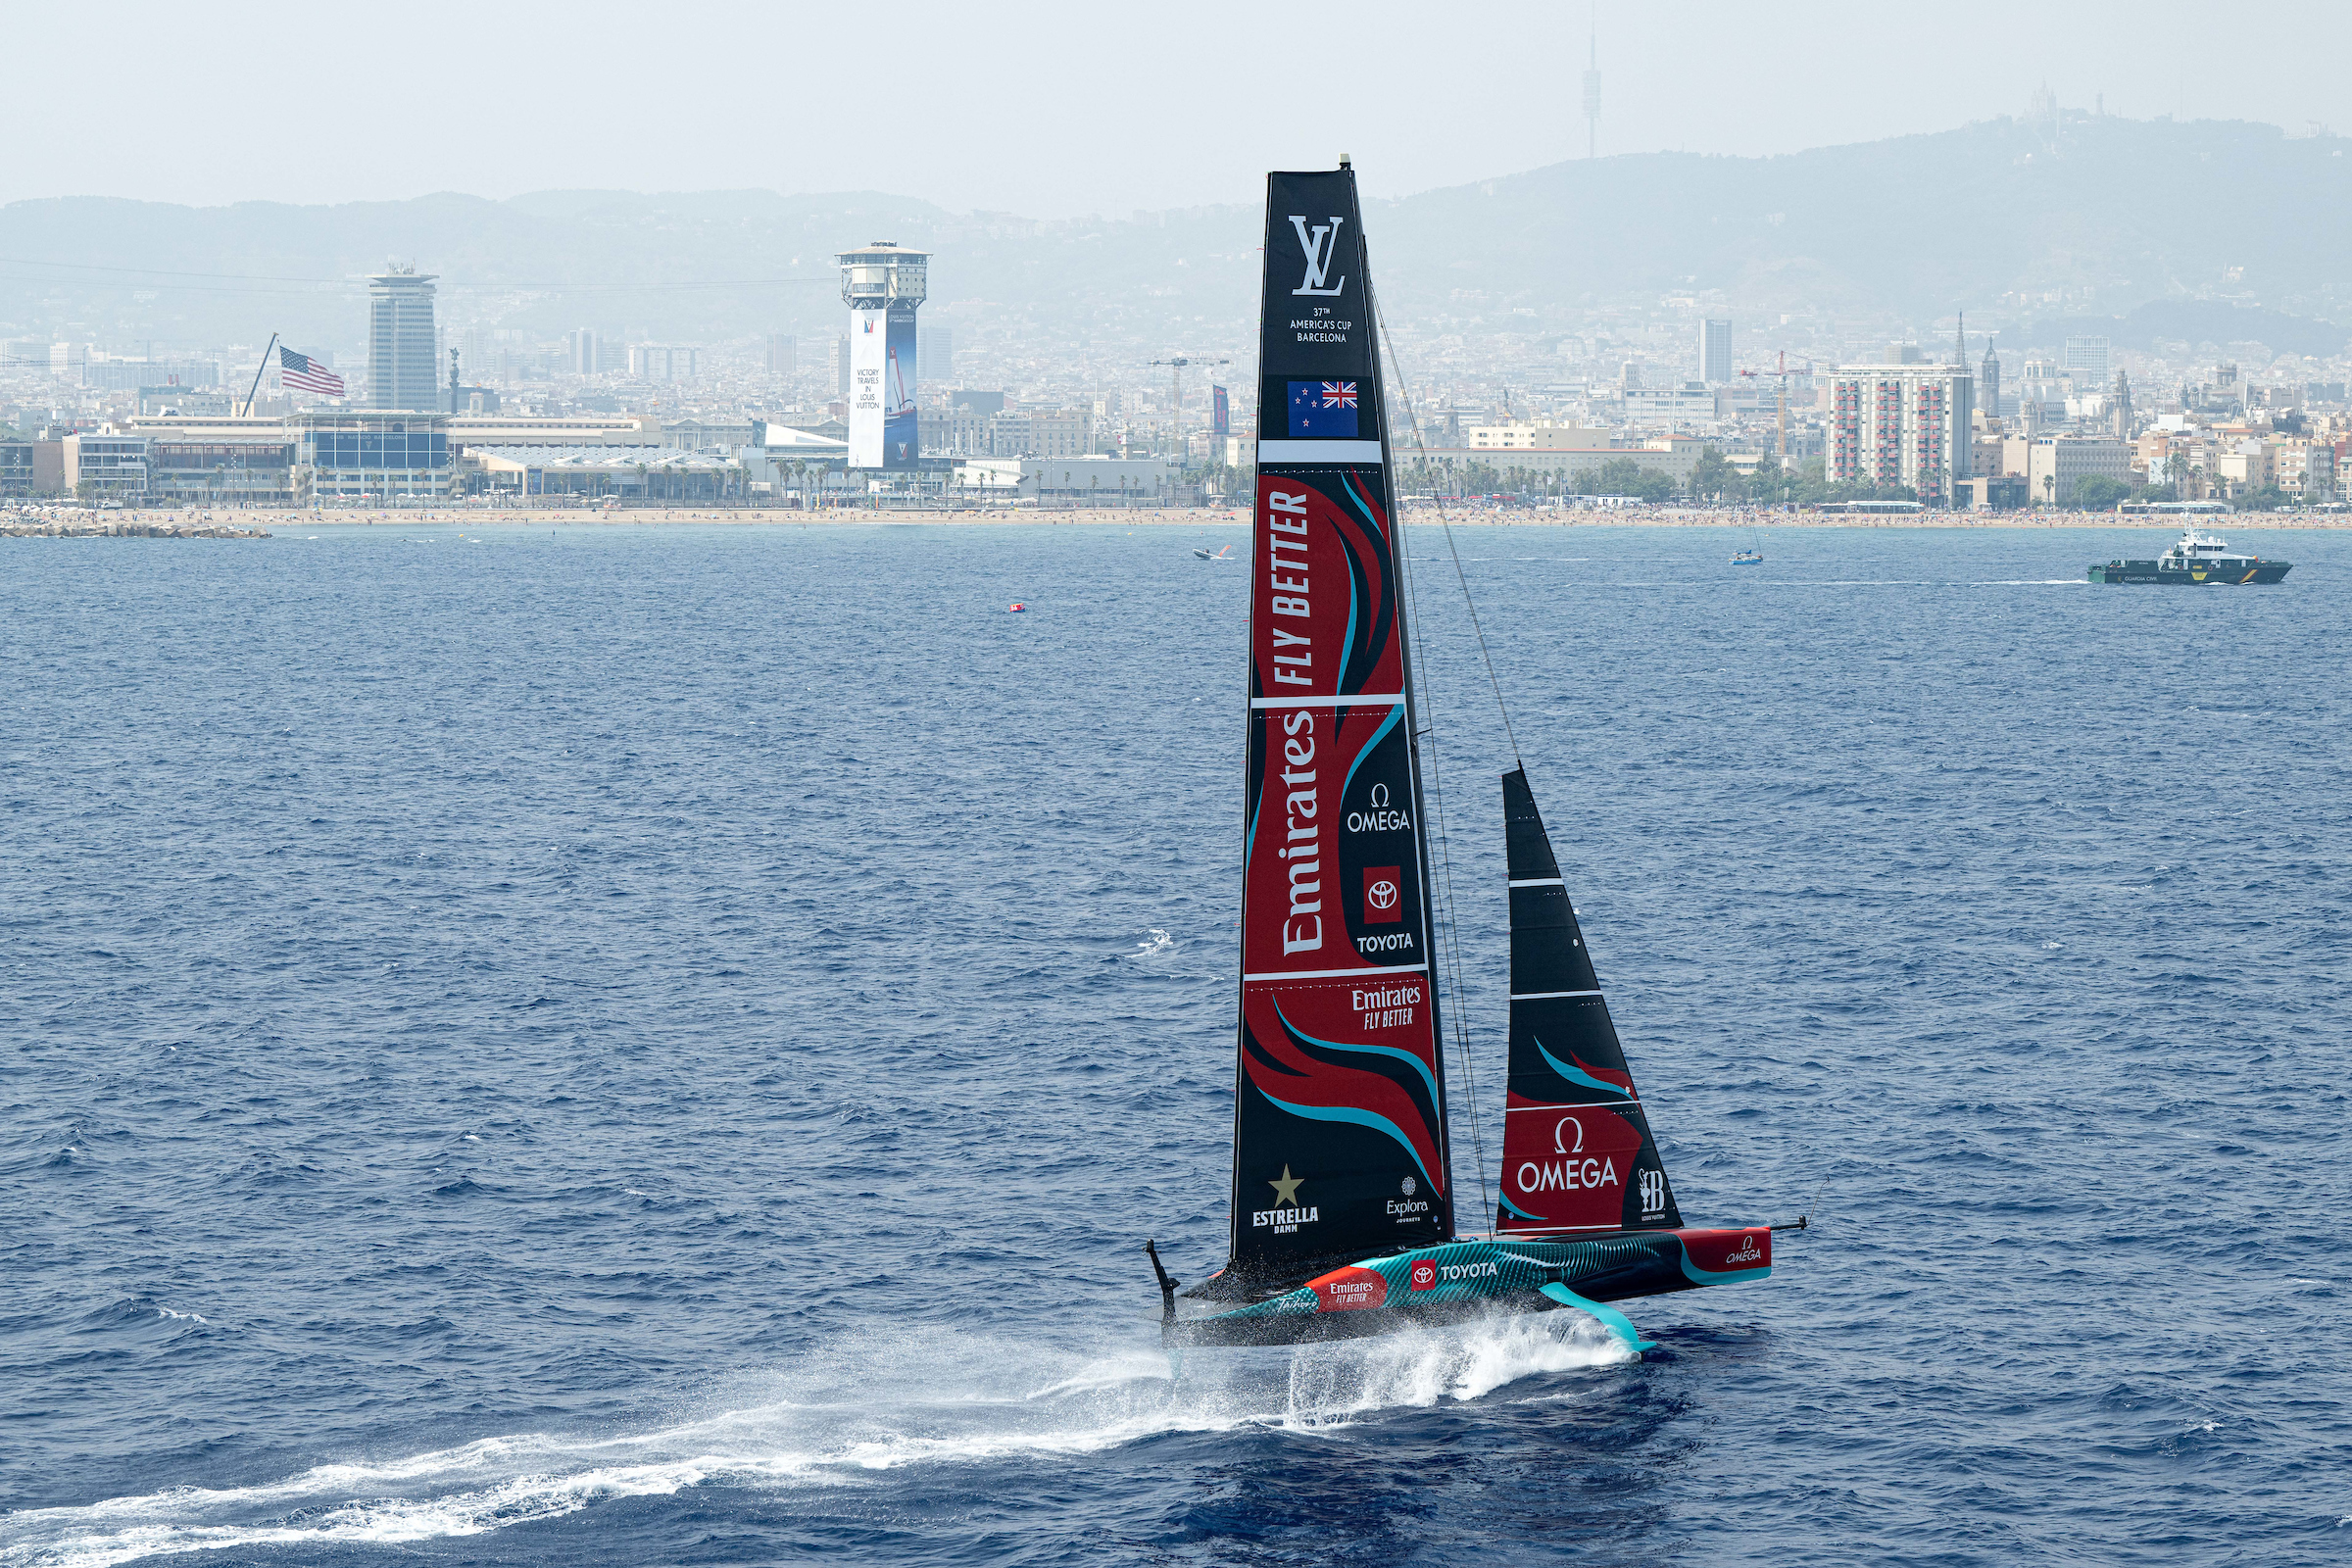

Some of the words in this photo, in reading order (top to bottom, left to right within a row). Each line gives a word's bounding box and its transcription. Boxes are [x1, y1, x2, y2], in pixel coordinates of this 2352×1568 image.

[1290, 319, 1336, 330] AMERICA'S
[1337, 320, 1352, 330] CUP
[1297, 332, 1348, 343] BARCELONA
[857, 376, 879, 385] TRAVELS
[1269, 490, 1311, 618] BETTER
[1272, 627, 1313, 686] FLY
[1347, 809, 1411, 833] OMEGA
[1278, 710, 1323, 957] Emirates
[1356, 932, 1414, 954] TOYOTA
[1351, 985, 1421, 1011] Emirates
[1363, 1011, 1381, 1031] FLY
[1382, 1007, 1413, 1028] BETTER
[1517, 1156, 1618, 1193] OMEGA
[1252, 1206, 1319, 1227] ESTRELLA
[1387, 1199, 1429, 1217] Explora
[1274, 1224, 1298, 1234] DAMM
[1726, 1249, 1761, 1264] OMEGA
[1441, 1261, 1497, 1281] TOYOTA
[1330, 1282, 1373, 1295] Emirates
[1336, 1294, 1347, 1303] FLY
[1347, 1293, 1367, 1303] BETTER
